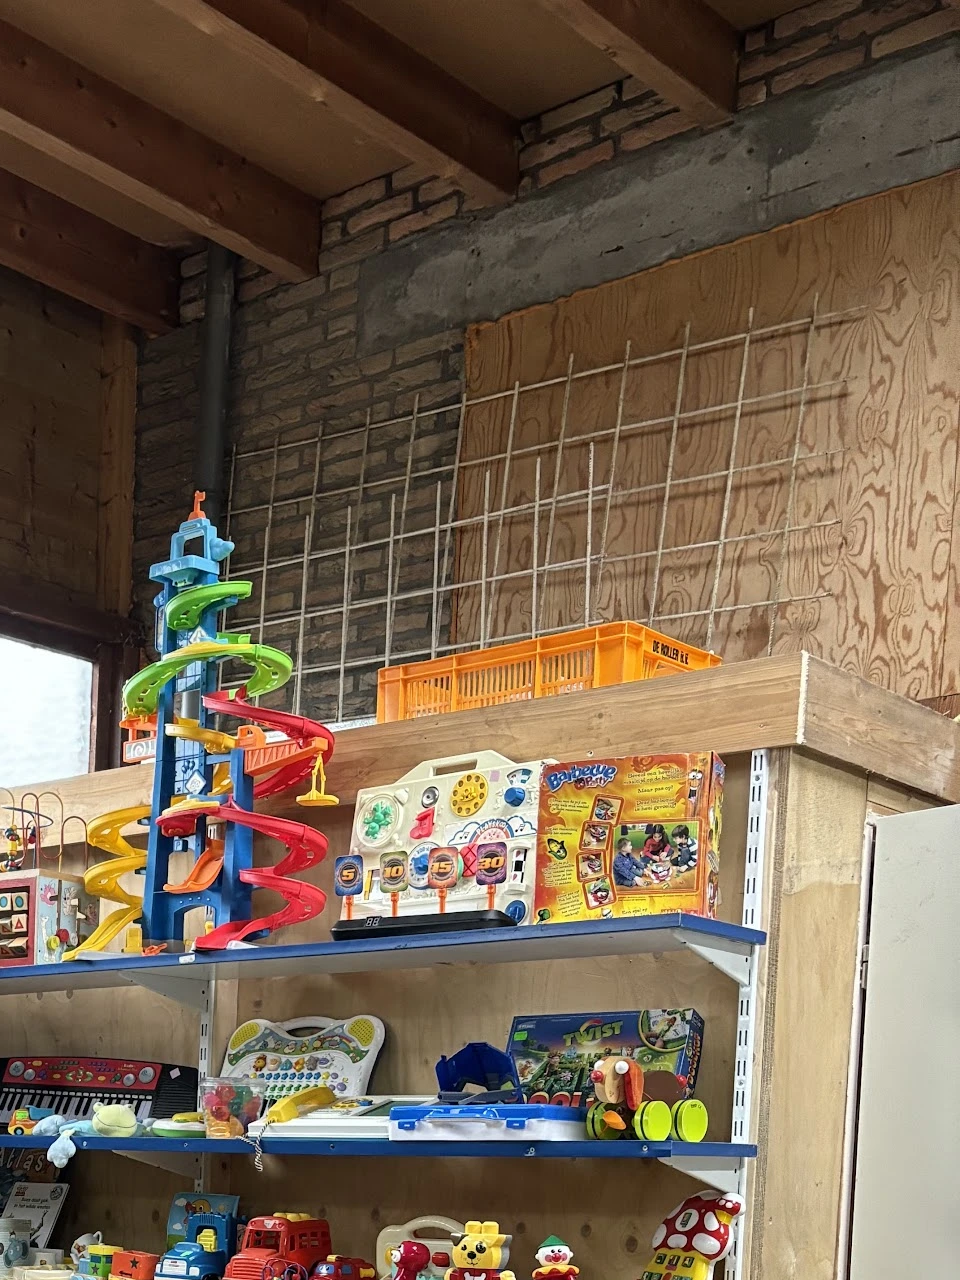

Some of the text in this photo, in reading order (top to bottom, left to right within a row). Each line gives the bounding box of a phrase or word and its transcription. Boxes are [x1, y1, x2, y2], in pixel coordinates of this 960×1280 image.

[652, 640, 660, 653] DE
[546, 764, 617, 791] Barbecue
[584, 775, 609, 788] Party
[430, 860, 453, 872] 15
[478, 856, 505, 870] 30
[340, 868, 356, 881] 5
[383, 865, 404, 877] 10
[563, 1019, 624, 1047] TWIST
